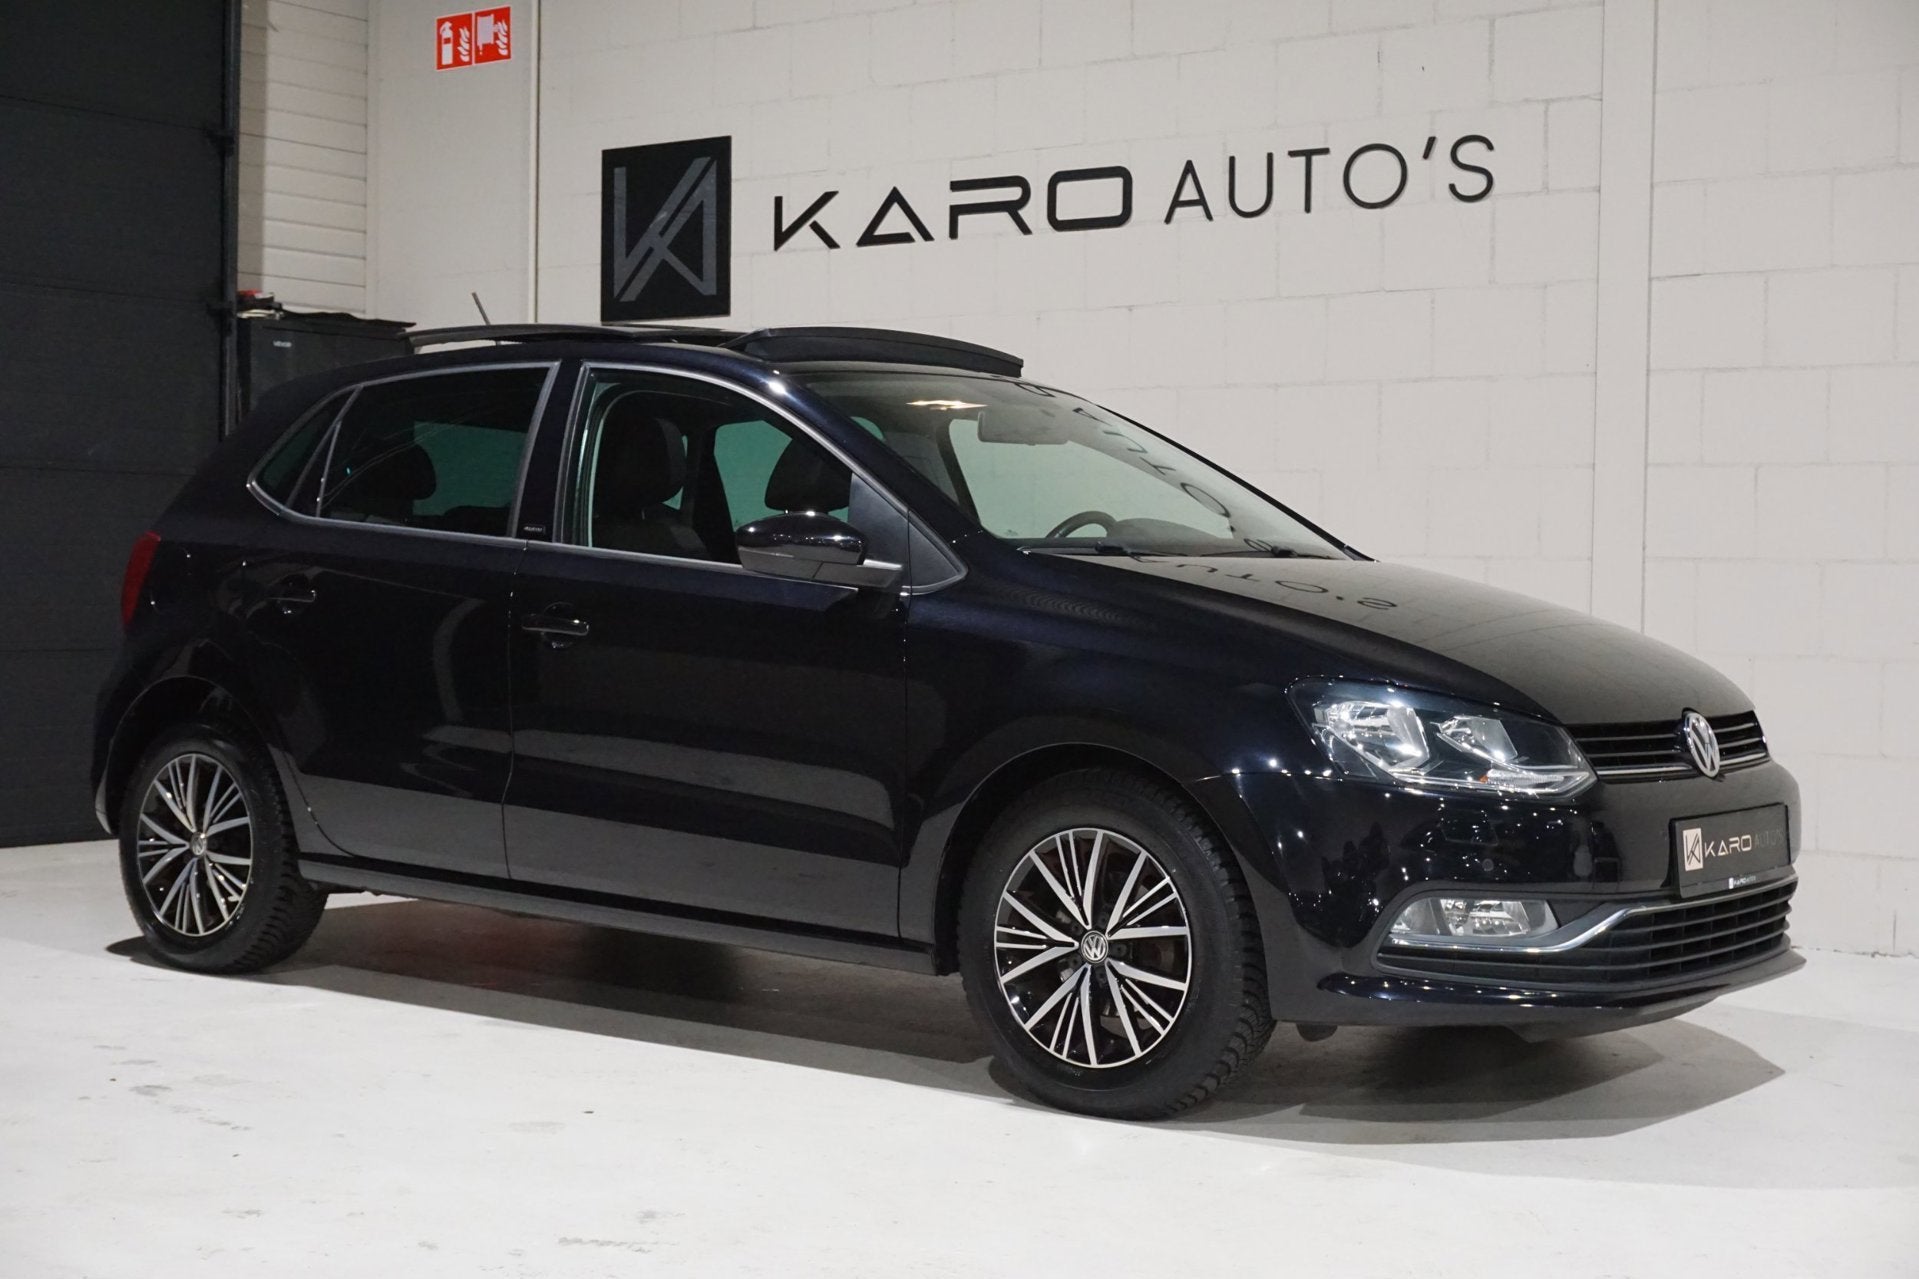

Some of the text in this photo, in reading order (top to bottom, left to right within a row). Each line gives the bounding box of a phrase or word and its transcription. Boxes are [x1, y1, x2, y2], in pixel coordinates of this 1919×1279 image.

[773, 134, 1496, 252] KARO AUTO'S
[1704, 834, 1752, 858] KARO
